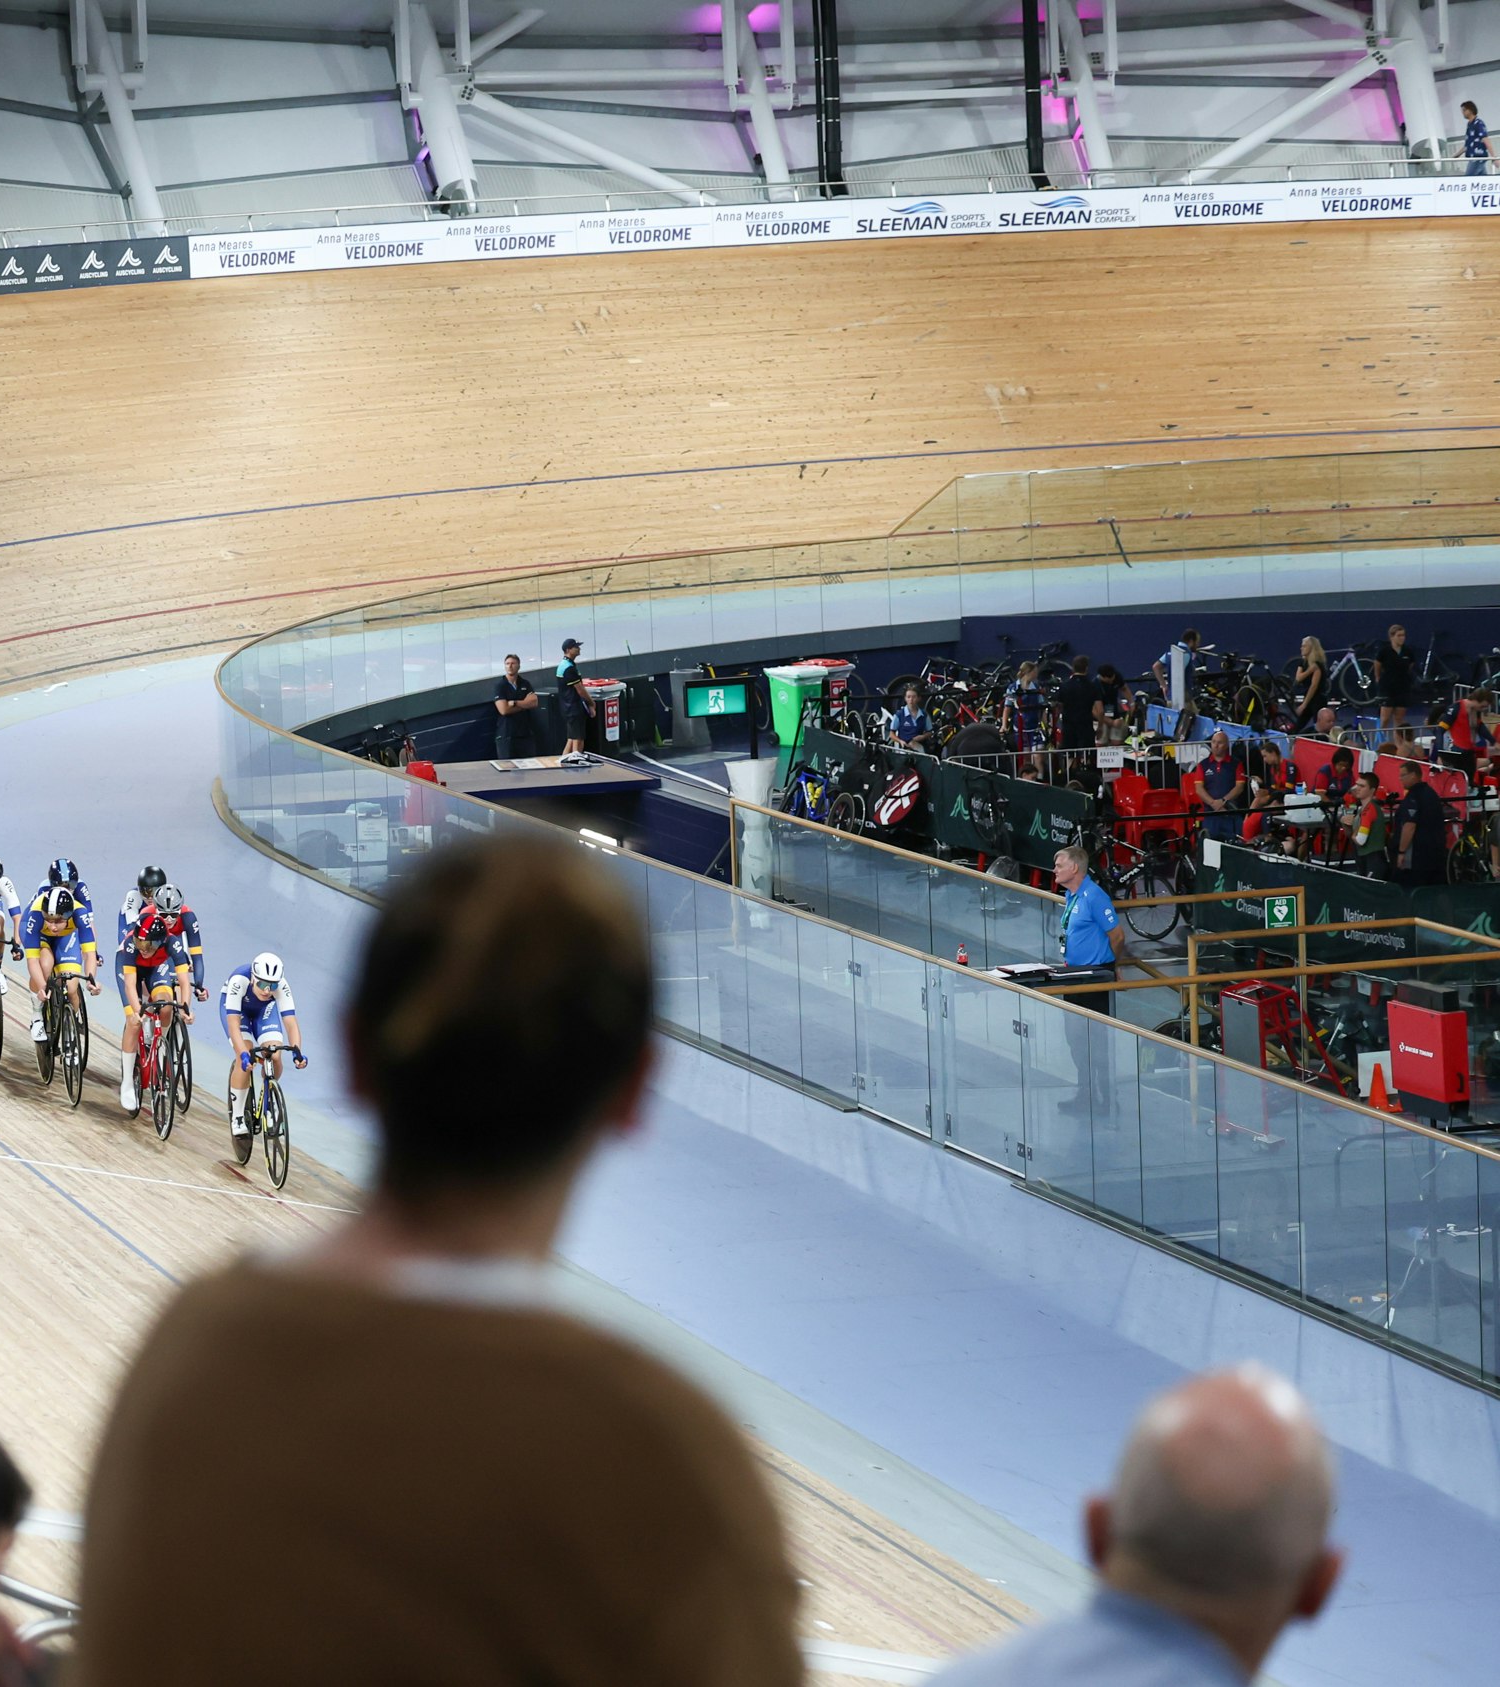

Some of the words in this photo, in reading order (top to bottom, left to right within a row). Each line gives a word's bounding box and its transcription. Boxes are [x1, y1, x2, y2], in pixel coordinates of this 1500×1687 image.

[1289, 187, 1318, 197] Anna
[1321, 185, 1362, 195] Meares
[1438, 183, 1467, 192] Anna
[1470, 182, 1500, 191] Mear
[1142, 192, 1170, 202] Anna
[1173, 191, 1214, 201] Meares
[1471, 195, 1500, 208] VEL
[1174, 202, 1264, 218] VELODROME
[1322, 197, 1412, 213] VELODROME
[579, 219, 605, 229] Anna
[607, 217, 646, 227] Meares
[715, 212, 742, 222] Anna
[745, 210, 784, 220] Meares
[856, 215, 948, 233] SLEEMAN
[951, 213, 985, 222] SPORTS
[998, 210, 1092, 227] SLEEMAN
[1094, 208, 1130, 217] SPORTS
[1094, 215, 1136, 224] COMPLEX
[446, 226, 471, 236] Anna
[474, 223, 511, 234] Meares
[746, 220, 831, 237] VELODROME
[950, 220, 992, 229] COMPLEX
[317, 234, 341, 244] Anna
[344, 232, 380, 242] Meares
[475, 234, 556, 252] VELODROME
[608, 227, 692, 245] VELODROME
[192, 242, 216, 252] Anna
[218, 240, 253, 250] Meares
[345, 242, 424, 260] VELODROME
[219, 250, 296, 269] VELODROME
[126, 897, 135, 911] VIC
[80, 913, 91, 929] ACT
[1343, 907, 1376, 922] National
[26, 916, 37, 934] ACT
[192, 921, 200, 934] SA
[172, 940, 183, 954] SA
[230, 982, 241, 996] VIC
[281, 984, 291, 997] VIC
